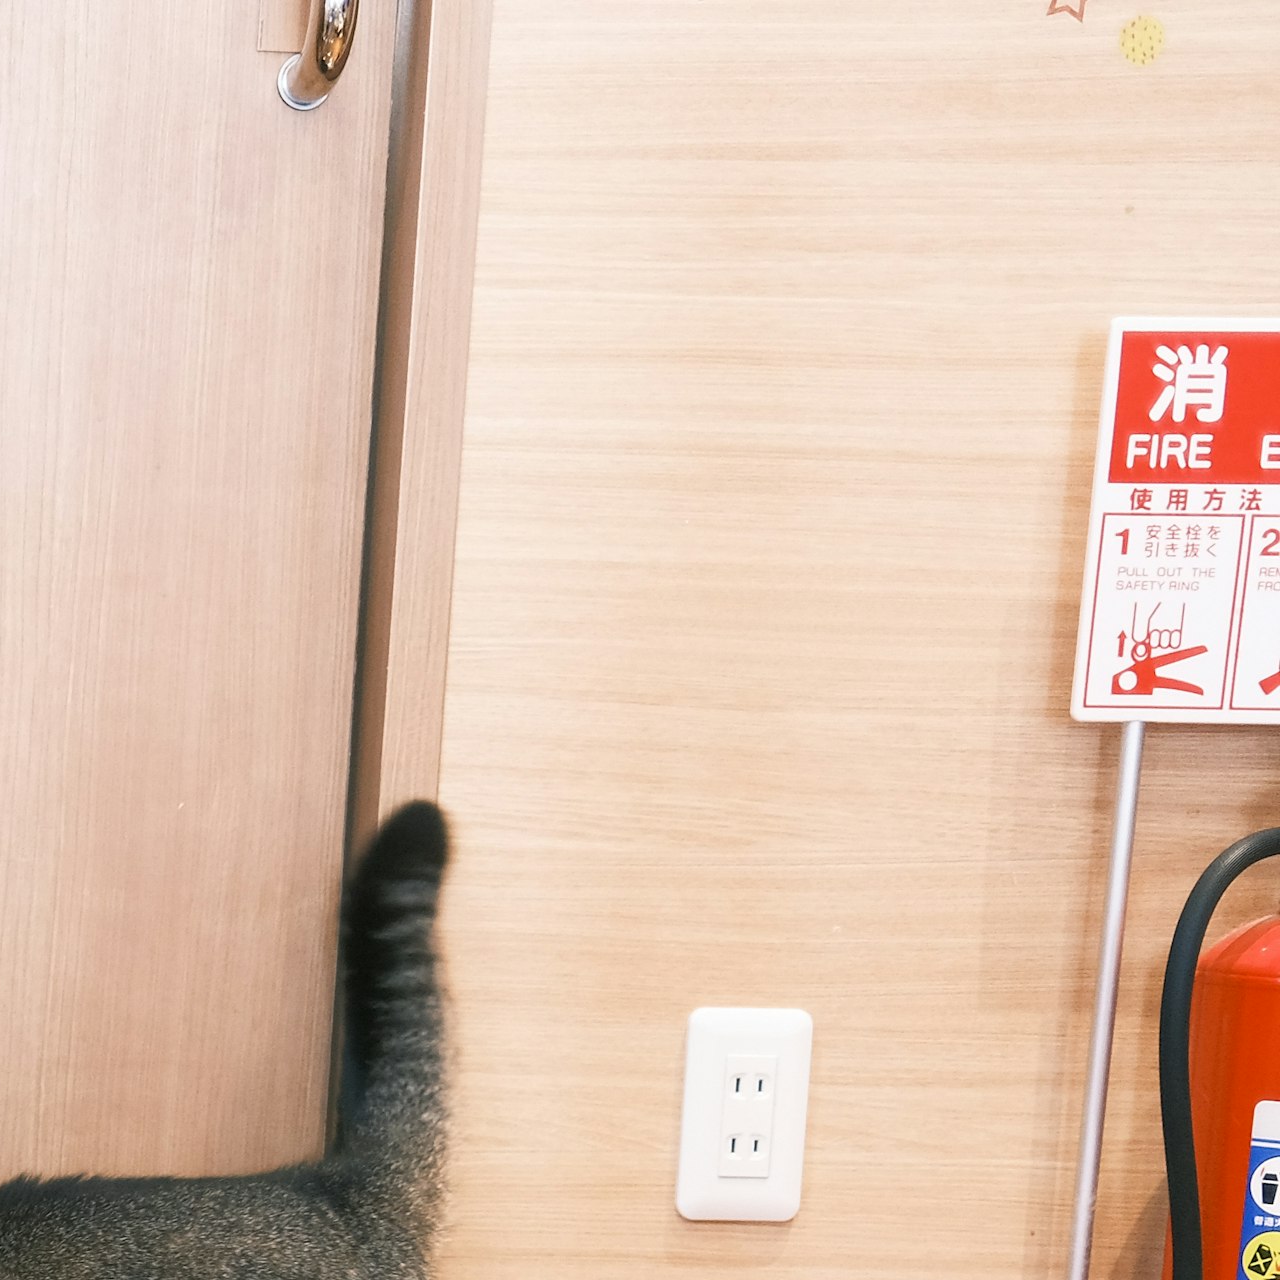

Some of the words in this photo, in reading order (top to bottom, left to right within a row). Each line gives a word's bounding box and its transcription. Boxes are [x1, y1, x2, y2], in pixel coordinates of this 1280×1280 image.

[1148, 344, 1228, 422] 消
[1126, 434, 1214, 469] FIRE
[1130, 488, 1262, 511] 使用方法
[1115, 528, 1130, 555] 1
[1146, 524, 1221, 540] 安全栓を
[1260, 528, 1280, 556] 2
[1144, 542, 1217, 558] 引き抜く
[1117, 566, 1148, 577] PULL
[1156, 567, 1183, 578] OUT
[1192, 567, 1216, 578] THE
[1115, 580, 1165, 591] SAFETY
[1169, 581, 1200, 592] RING
